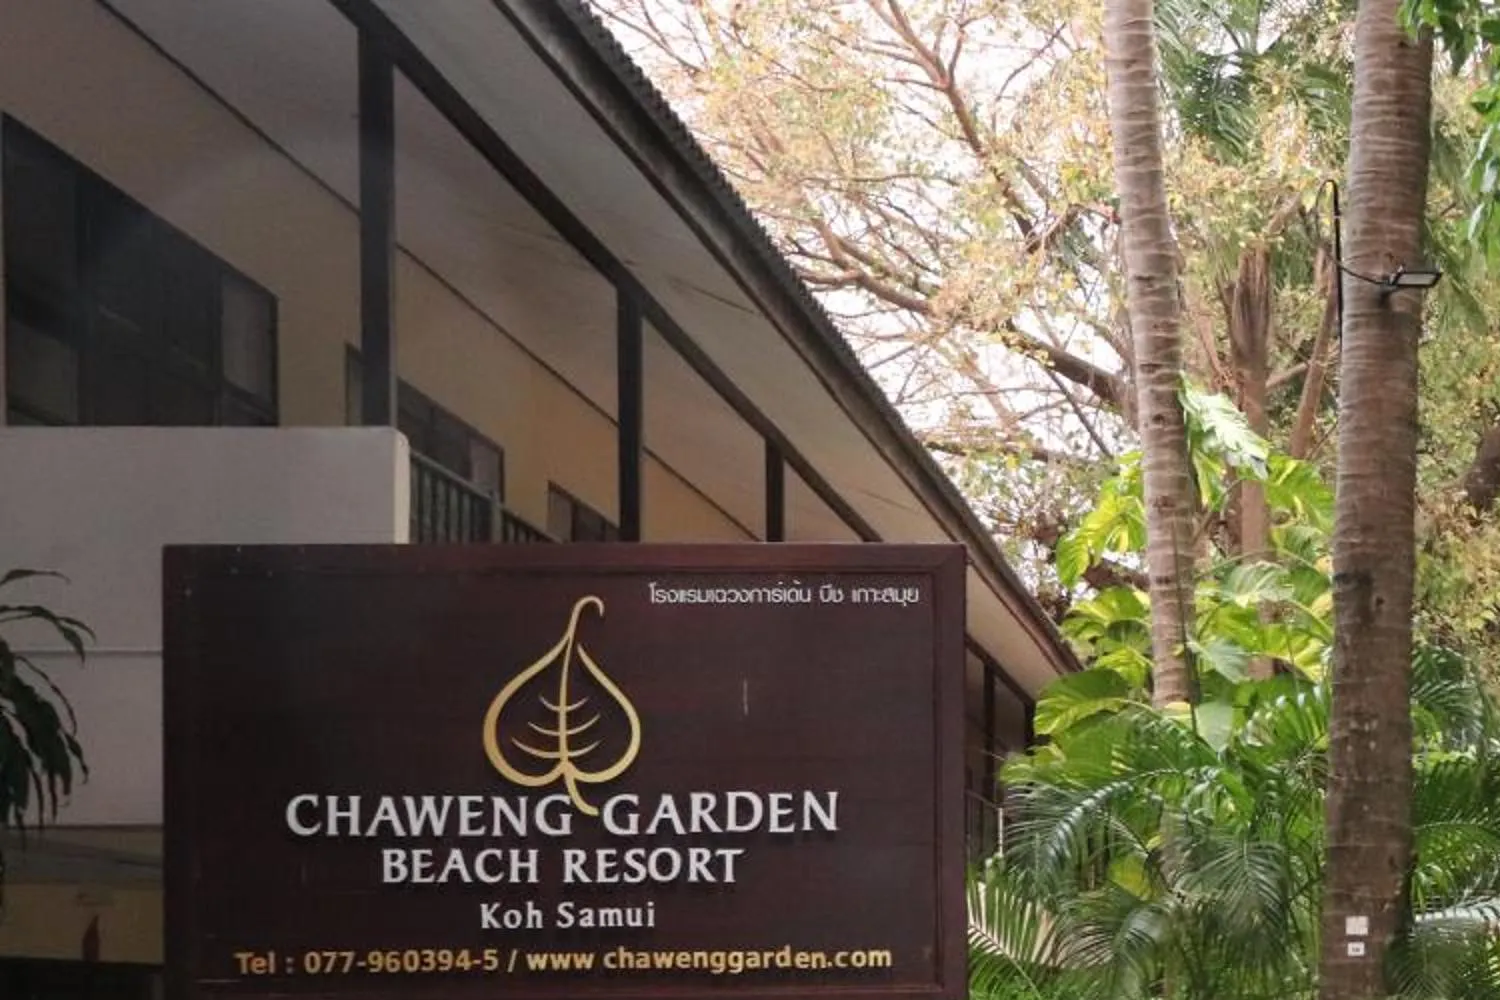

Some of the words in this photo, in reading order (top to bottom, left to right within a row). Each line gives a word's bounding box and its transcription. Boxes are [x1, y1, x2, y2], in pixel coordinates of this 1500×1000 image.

[819, 583, 844, 603] บีช
[851, 586, 920, 607] เกาะสมุย
[285, 793, 573, 837] CHAWENG
[602, 790, 839, 836] GARDEN
[382, 847, 540, 884] BEACH
[562, 846, 745, 883] RESORT
[479, 900, 544, 930] Koh
[556, 900, 656, 929] Samui
[234, 952, 276, 975] Tel
[303, 949, 499, 973] 077-960394-5
[603, 945, 892, 974] chawenggarden.com
